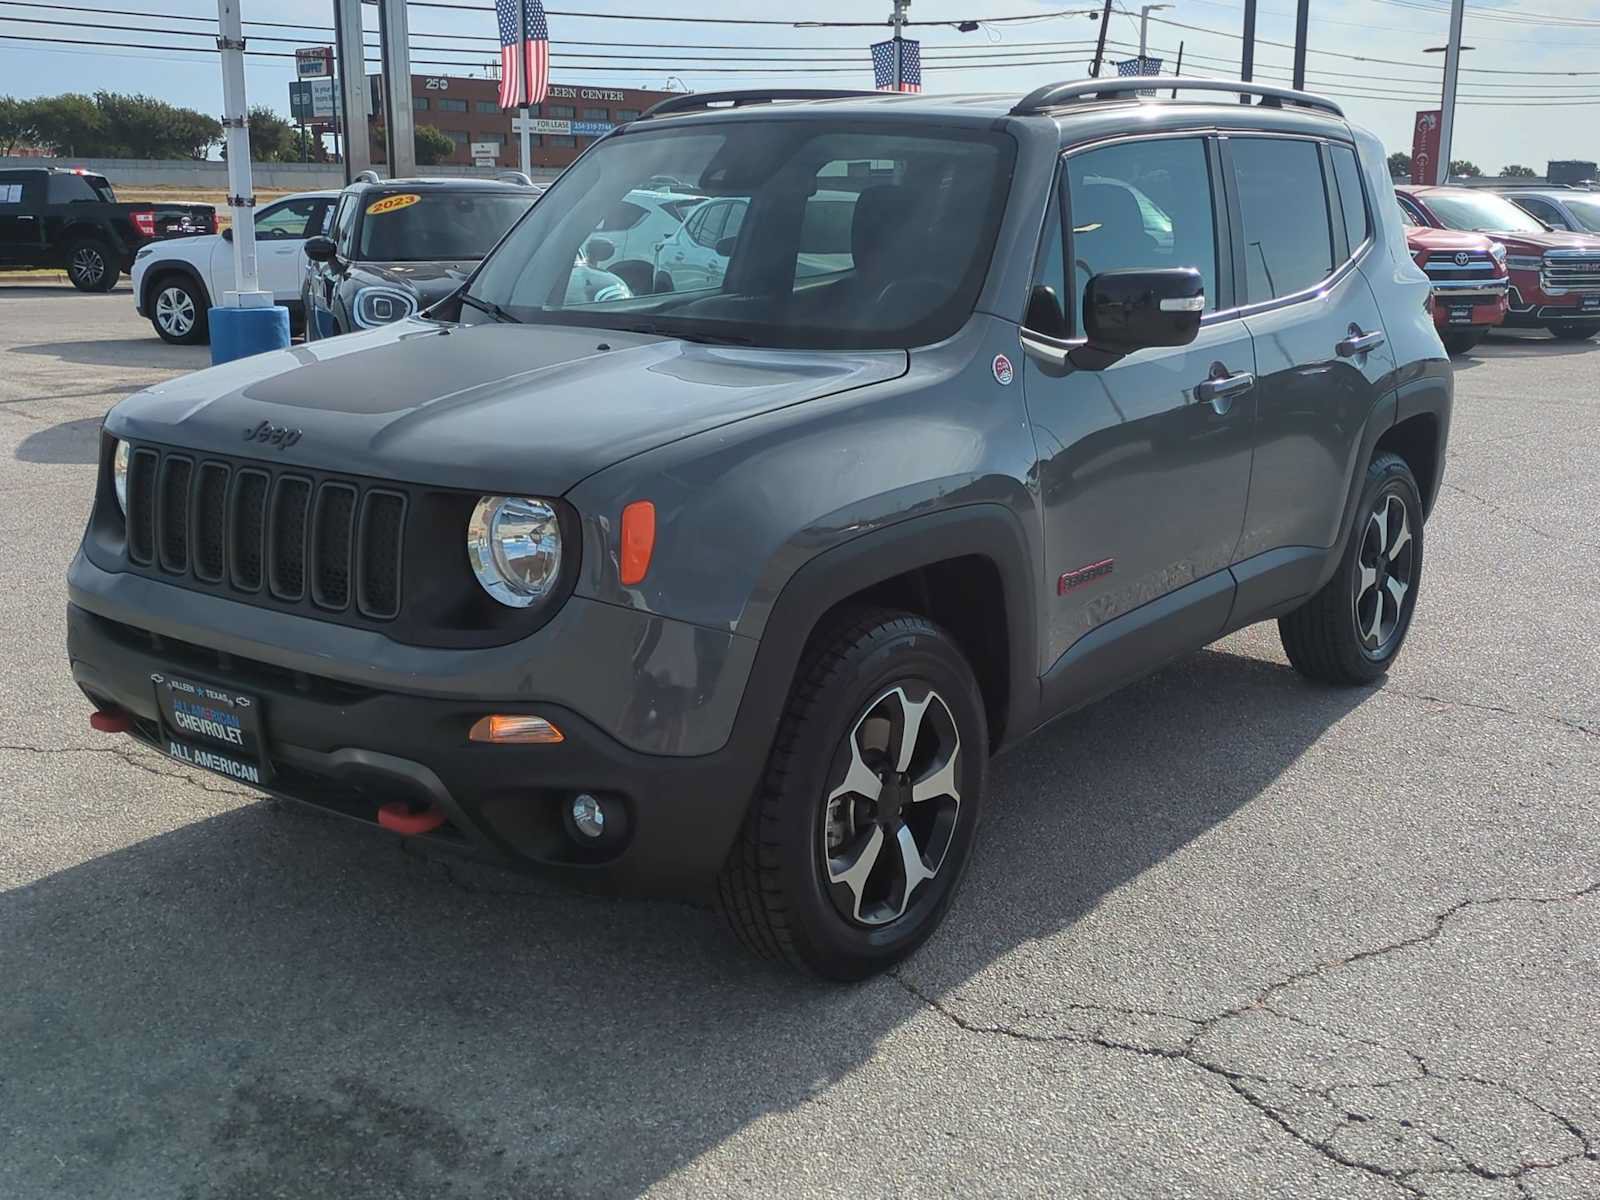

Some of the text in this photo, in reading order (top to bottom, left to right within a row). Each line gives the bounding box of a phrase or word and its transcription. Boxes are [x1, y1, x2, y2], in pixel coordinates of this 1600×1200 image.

[547, 87, 624, 102] LEEN CENTER
[537, 120, 549, 128] FOR
[551, 121, 569, 129] LEASE
[372, 195, 416, 213] 2023
[242, 419, 304, 451] Jeep
[206, 688, 229, 703] TEXAS
[175, 699, 241, 728] ALL AMERICAN
[175, 711, 243, 745] CHEVROLET
[170, 741, 259, 783] ALL AMERICAN
